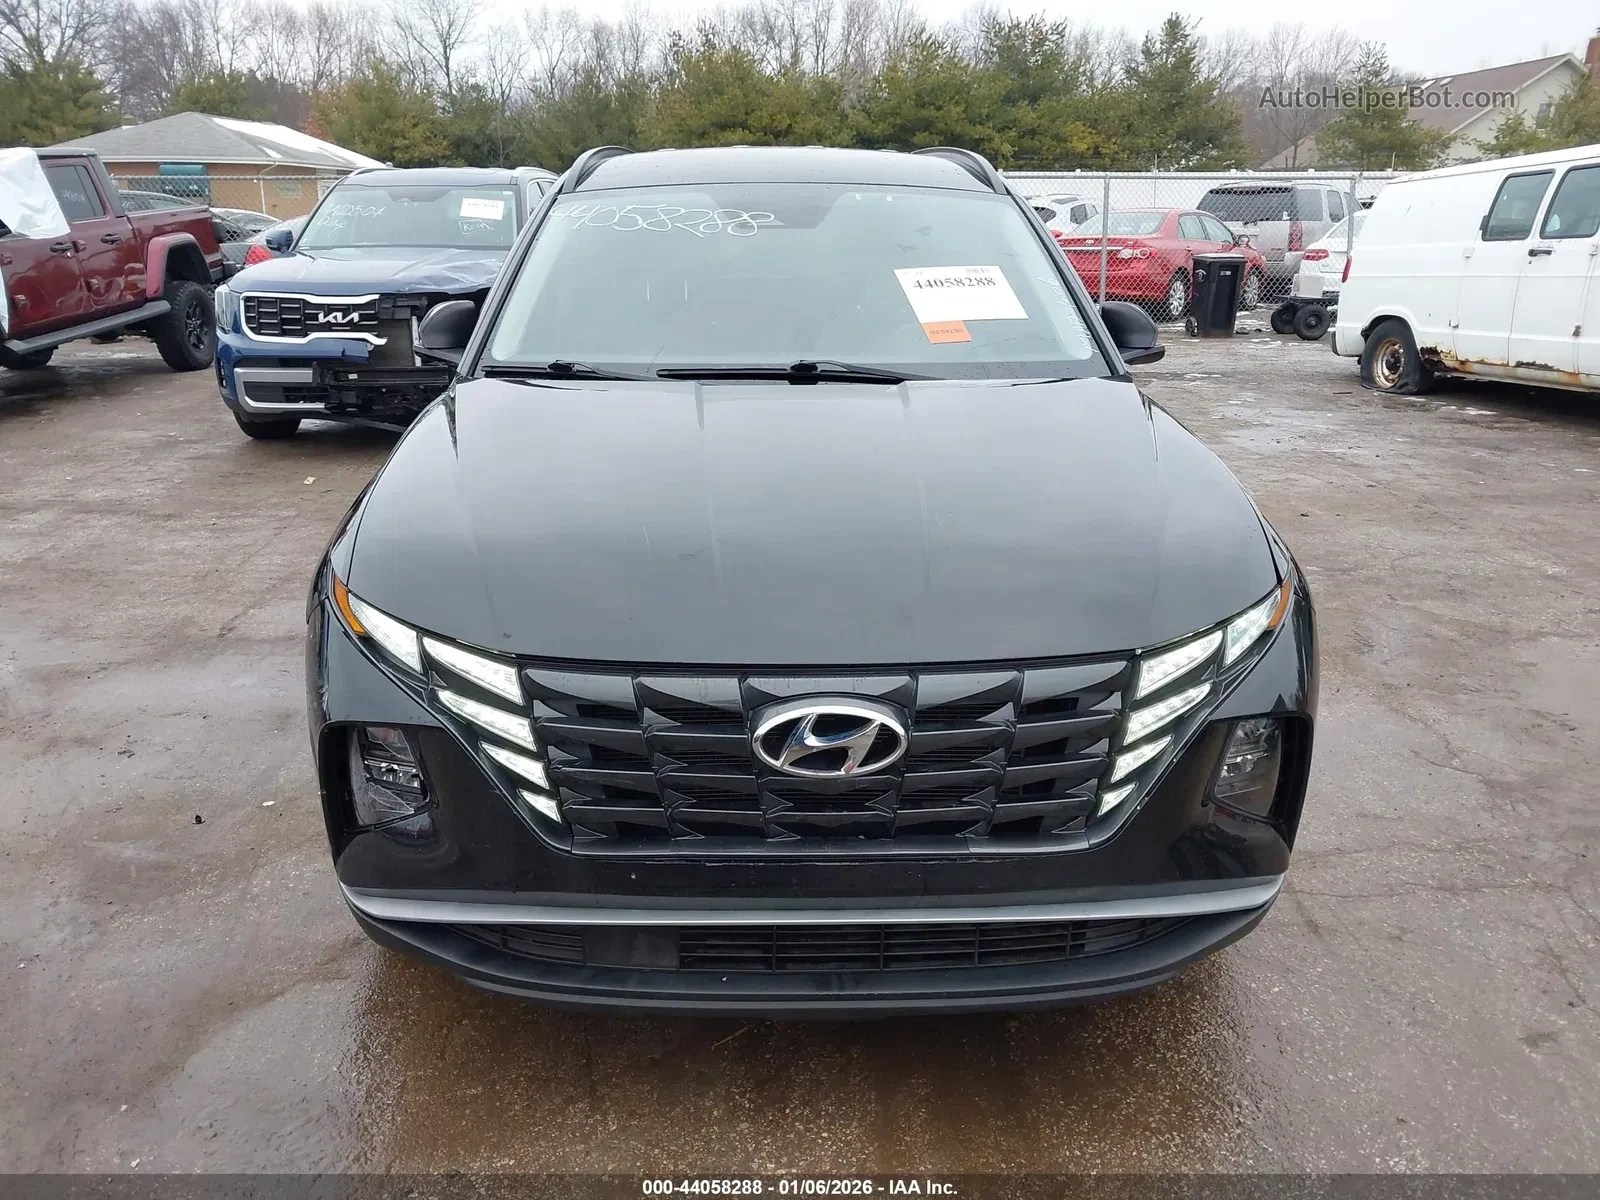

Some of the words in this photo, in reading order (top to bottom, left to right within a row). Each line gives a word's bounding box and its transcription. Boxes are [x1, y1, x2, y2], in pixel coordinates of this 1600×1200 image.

[550, 204, 775, 238] 44058288
[914, 276, 996, 289] 44058288
[318, 311, 359, 324] KIA
